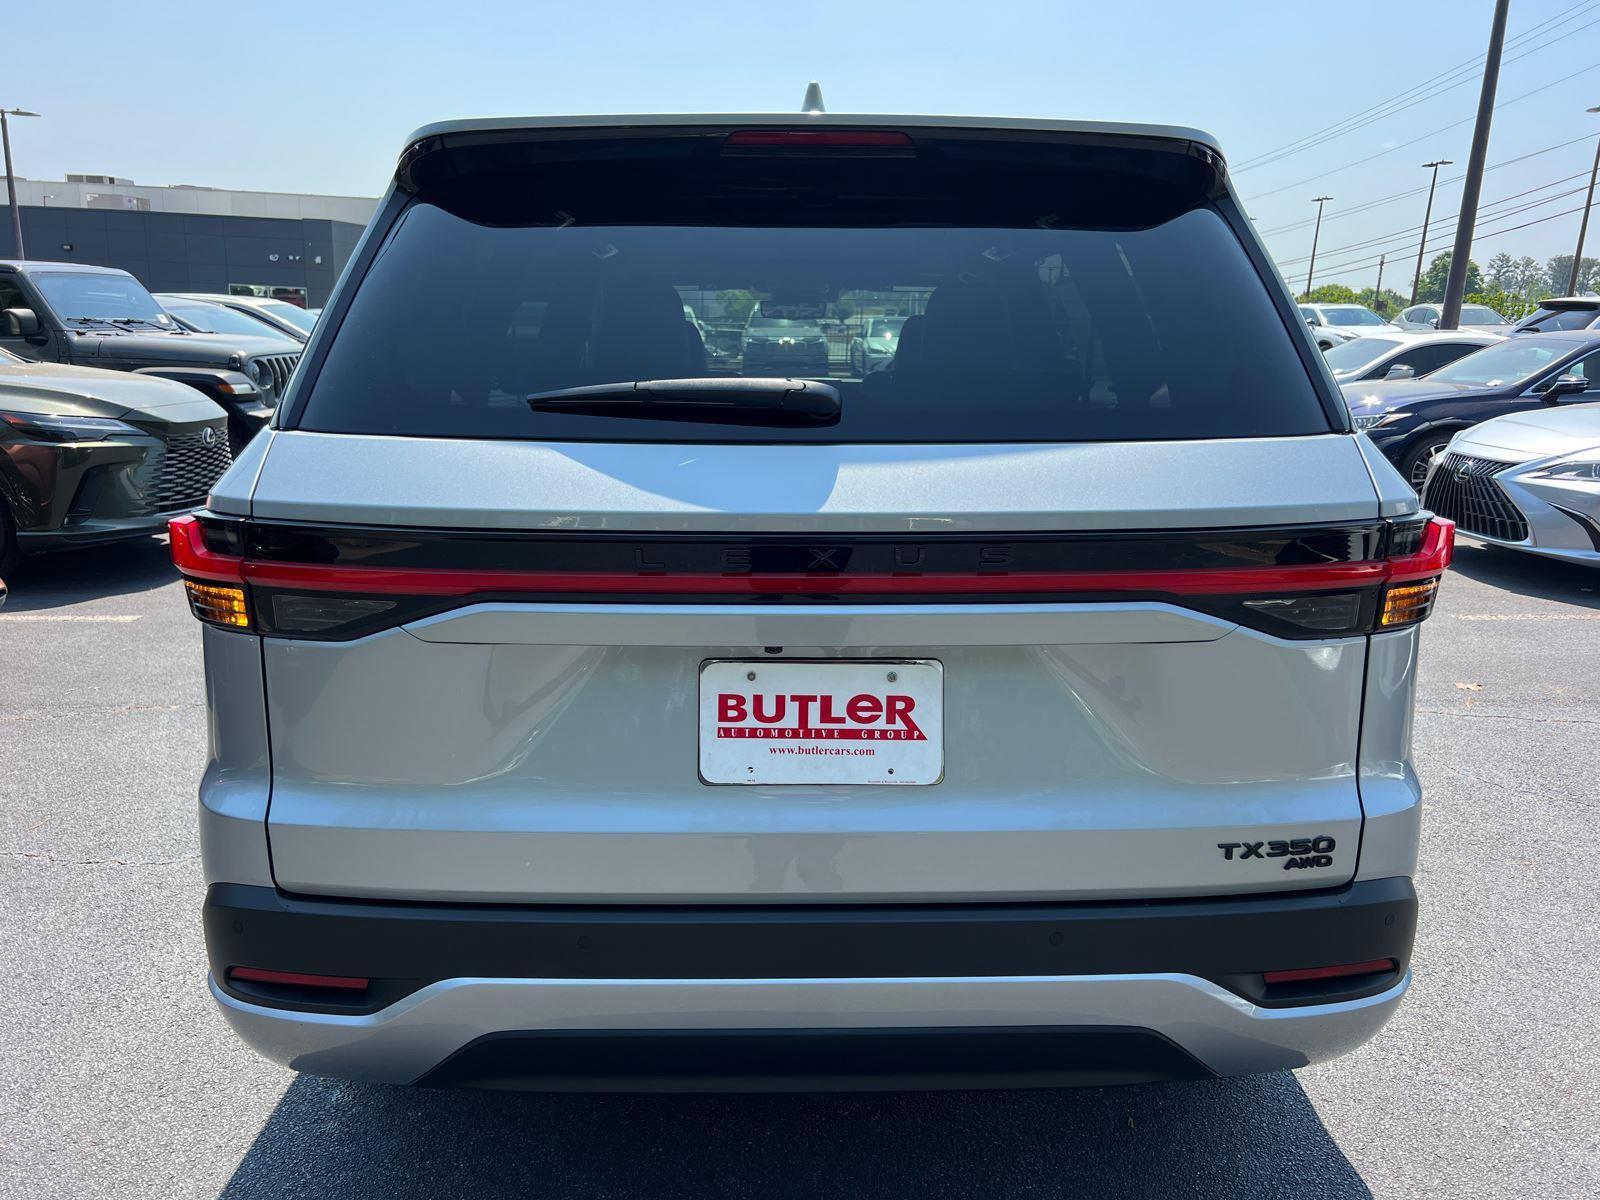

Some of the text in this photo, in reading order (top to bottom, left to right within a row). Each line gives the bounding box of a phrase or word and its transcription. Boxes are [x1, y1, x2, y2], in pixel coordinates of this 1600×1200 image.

[635, 546, 1012, 569] LEXUS
[717, 728, 921, 741] AUTOMOTIVE GROUP
[769, 746, 876, 757] www.butlercars.com
[1217, 835, 1336, 861] TX350
[1283, 855, 1333, 870] AWD
